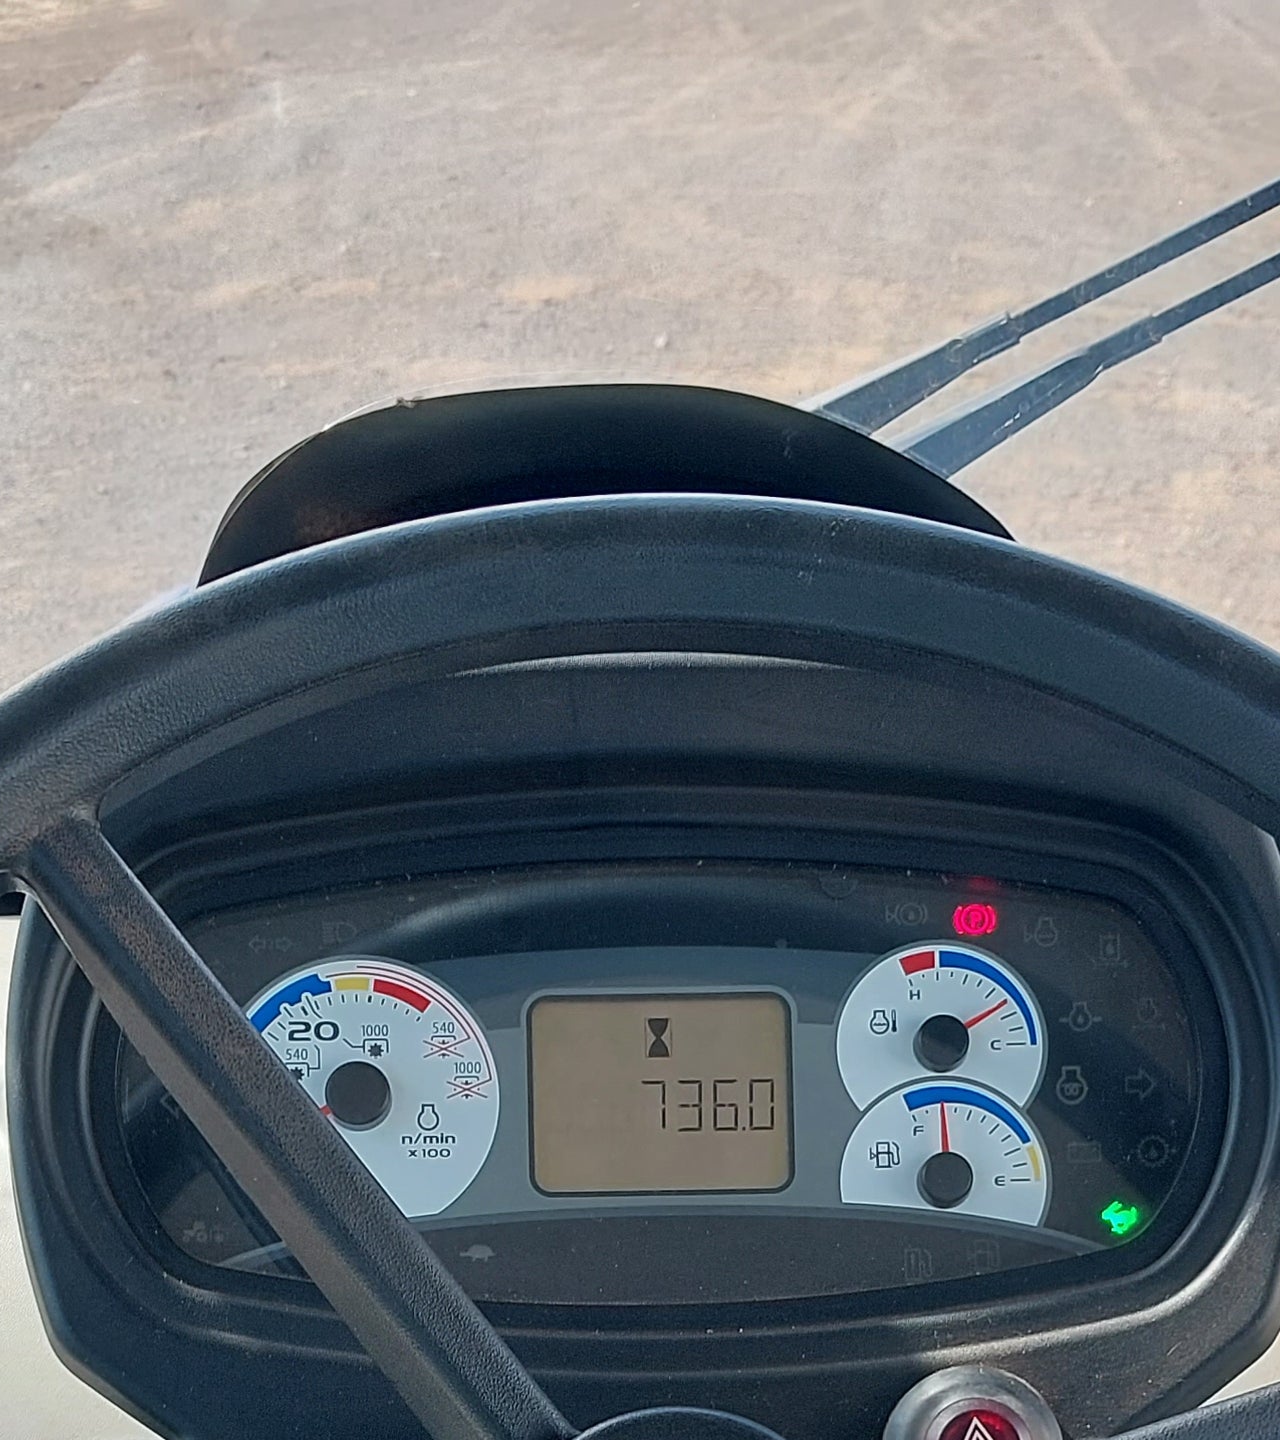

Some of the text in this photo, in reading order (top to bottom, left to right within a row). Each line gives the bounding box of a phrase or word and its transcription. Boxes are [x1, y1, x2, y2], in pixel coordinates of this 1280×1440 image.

[909, 989, 921, 1000] H
[288, 1021, 340, 1042] 20
[361, 1024, 390, 1037] 1000
[431, 1021, 456, 1034] 540
[990, 1039, 1002, 1050] C
[285, 1047, 309, 1060] 540
[453, 1062, 482, 1074] 1000
[641, 1078, 775, 1132] 736.0
[913, 1125, 925, 1137] F
[401, 1131, 457, 1146] n/min
[994, 1176, 1006, 1187] E
